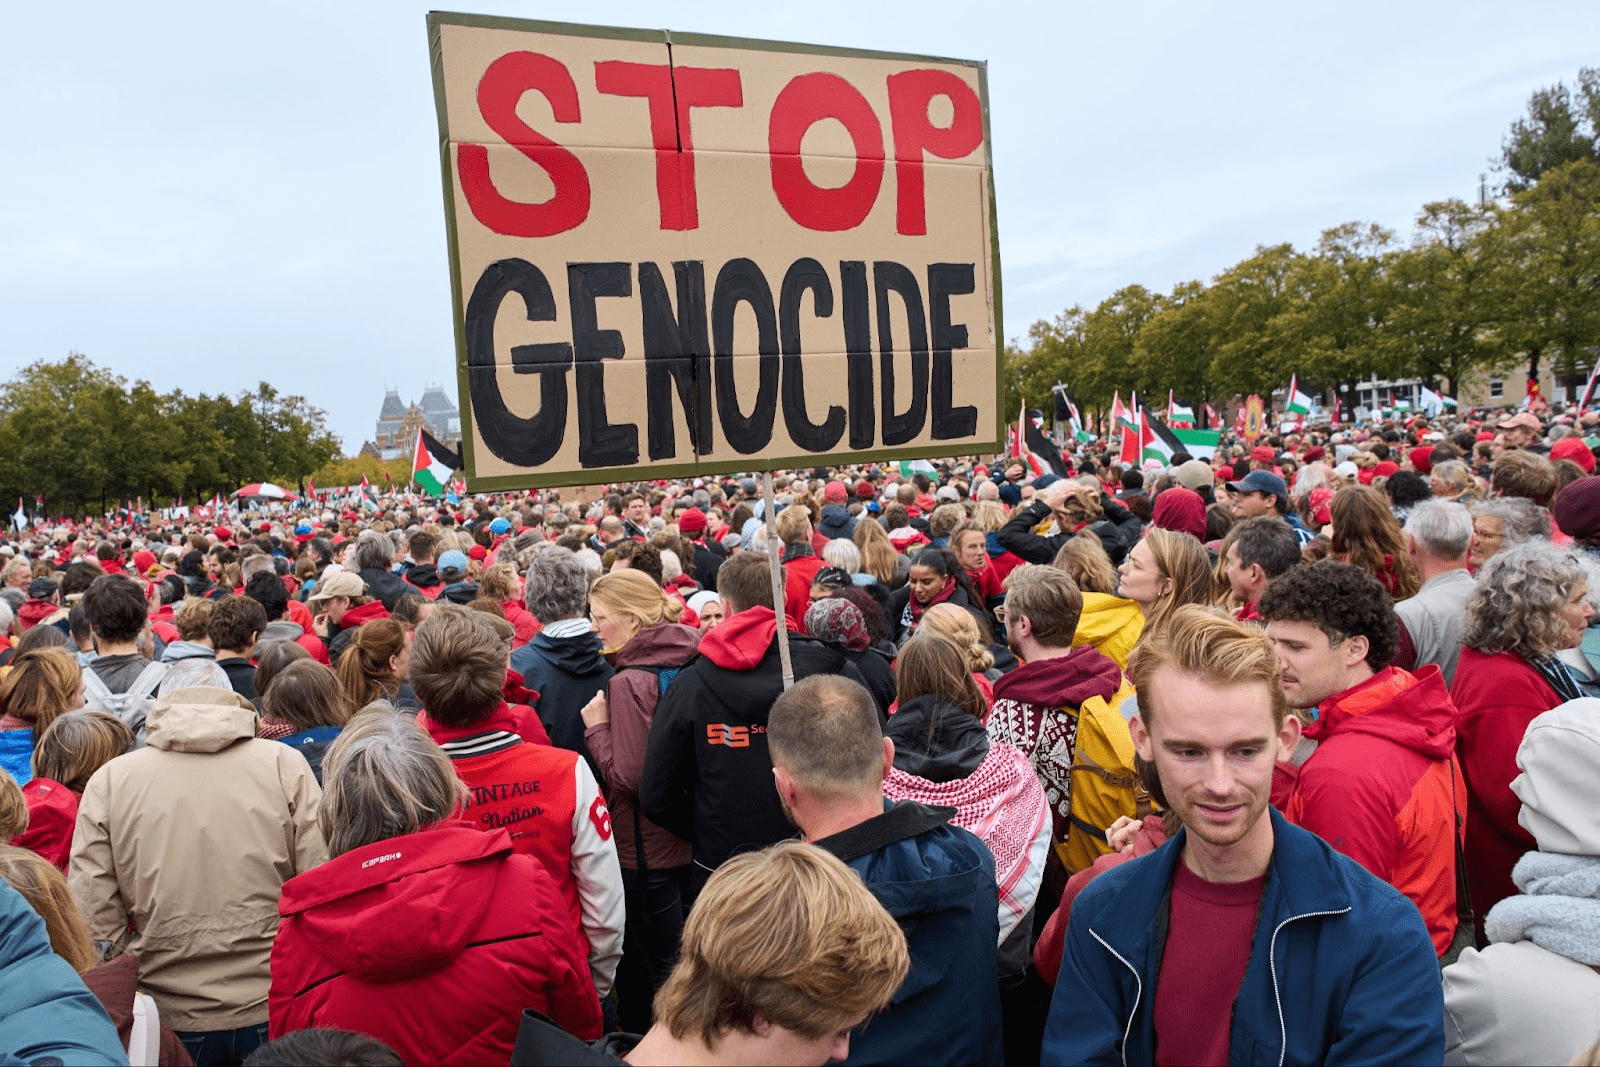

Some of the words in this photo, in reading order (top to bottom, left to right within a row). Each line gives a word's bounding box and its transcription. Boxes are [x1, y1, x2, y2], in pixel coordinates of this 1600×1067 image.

[457, 50, 983, 238] STOP
[465, 257, 978, 468] GENOCIDE
[481, 806, 545, 829] Nation
